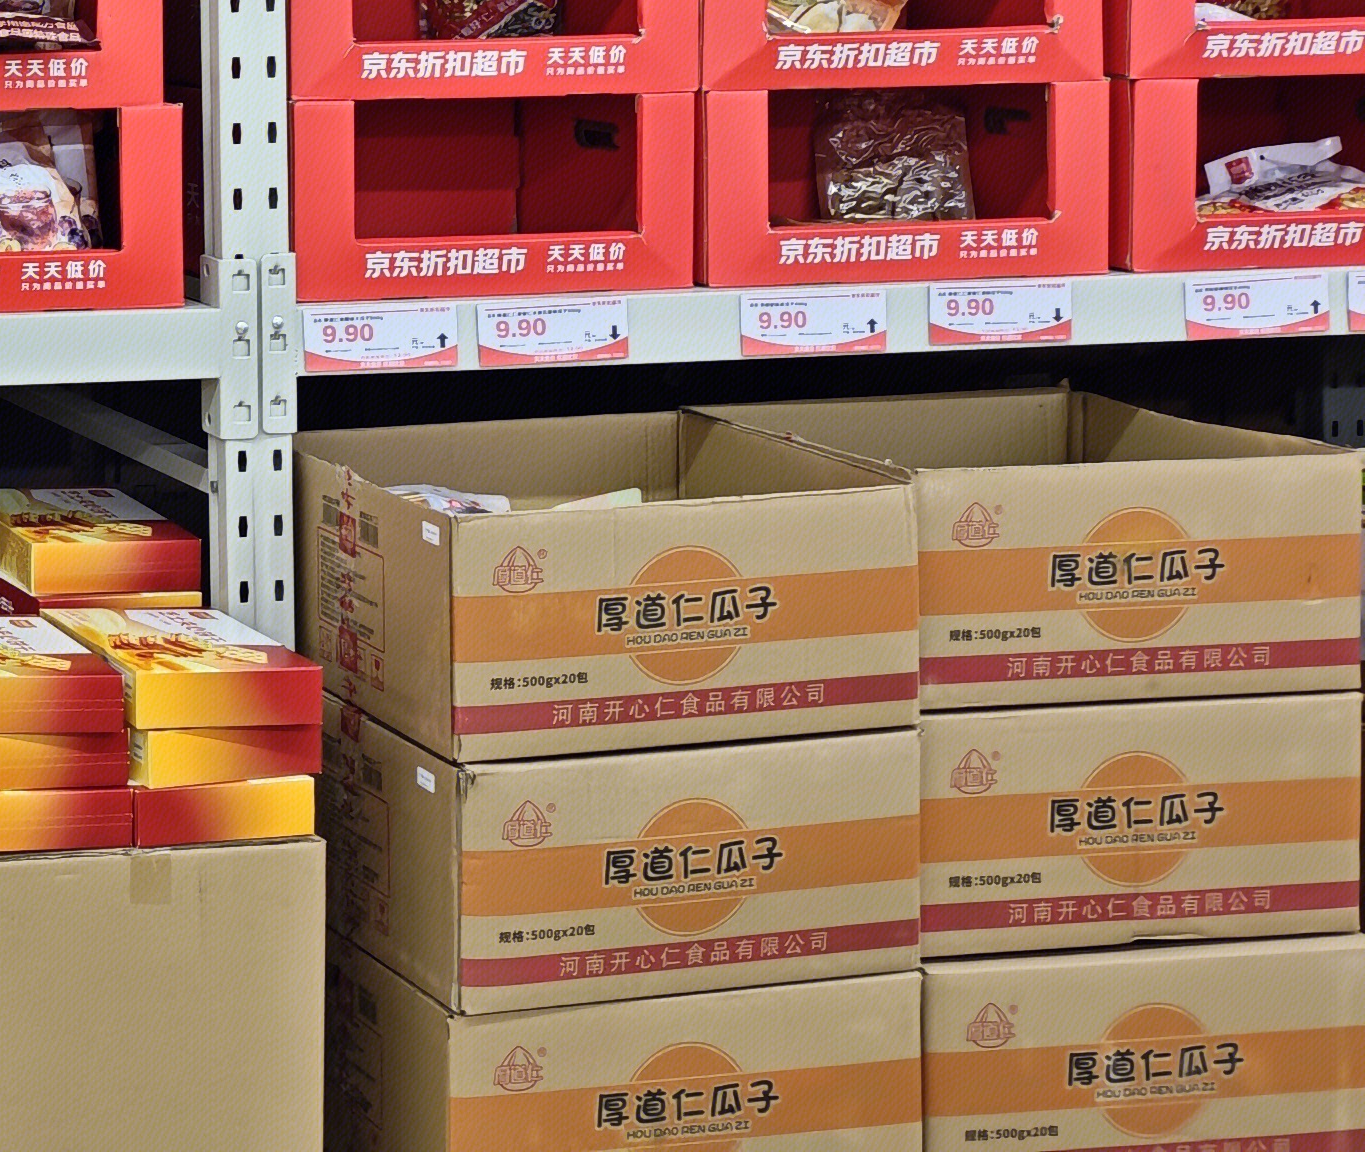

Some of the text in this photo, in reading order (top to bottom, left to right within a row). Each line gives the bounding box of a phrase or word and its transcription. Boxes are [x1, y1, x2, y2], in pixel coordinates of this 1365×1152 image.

[546, 46, 626, 65] 天天低价
[775, 41, 940, 70] 京东折扣超市
[959, 37, 1039, 56] 天天低价
[1202, 30, 1365, 58] 京东折扣超市
[4, 58, 88, 77] 天天低价
[361, 50, 527, 78] 京东折扣超市
[779, 233, 940, 264] 京东折扣超市
[960, 229, 1038, 248] 天天低价
[1204, 222, 1363, 251] 京东折扣超市
[365, 247, 527, 278] 京东折扣超市
[547, 243, 625, 262] 天天低价
[21, 261, 106, 280] 天天低价
[946, 298, 993, 316] 9.90
[1203, 293, 1250, 312] 9.90
[322, 324, 374, 343] 9.90
[495, 318, 546, 338] 9.90
[758, 311, 807, 329] 9.90
[1051, 548, 1225, 587] 厚道仁瓜子
[597, 586, 777, 633] 厚道仁瓜子
[1008, 646, 1270, 678] 河南开心仁食品有限公司
[552, 684, 826, 725] 河南开心仁食品有限公司
[1050, 792, 1224, 833] 厚道仁瓜子
[605, 837, 783, 885] 厚道仁瓜子
[1008, 889, 1271, 924] 河南开心仁食品有限公司
[559, 932, 828, 976] 河南开心仁食品有限公司
[1068, 1043, 1244, 1086] 厚道仁瓜子
[597, 1080, 779, 1128] 厚道仁瓜子
